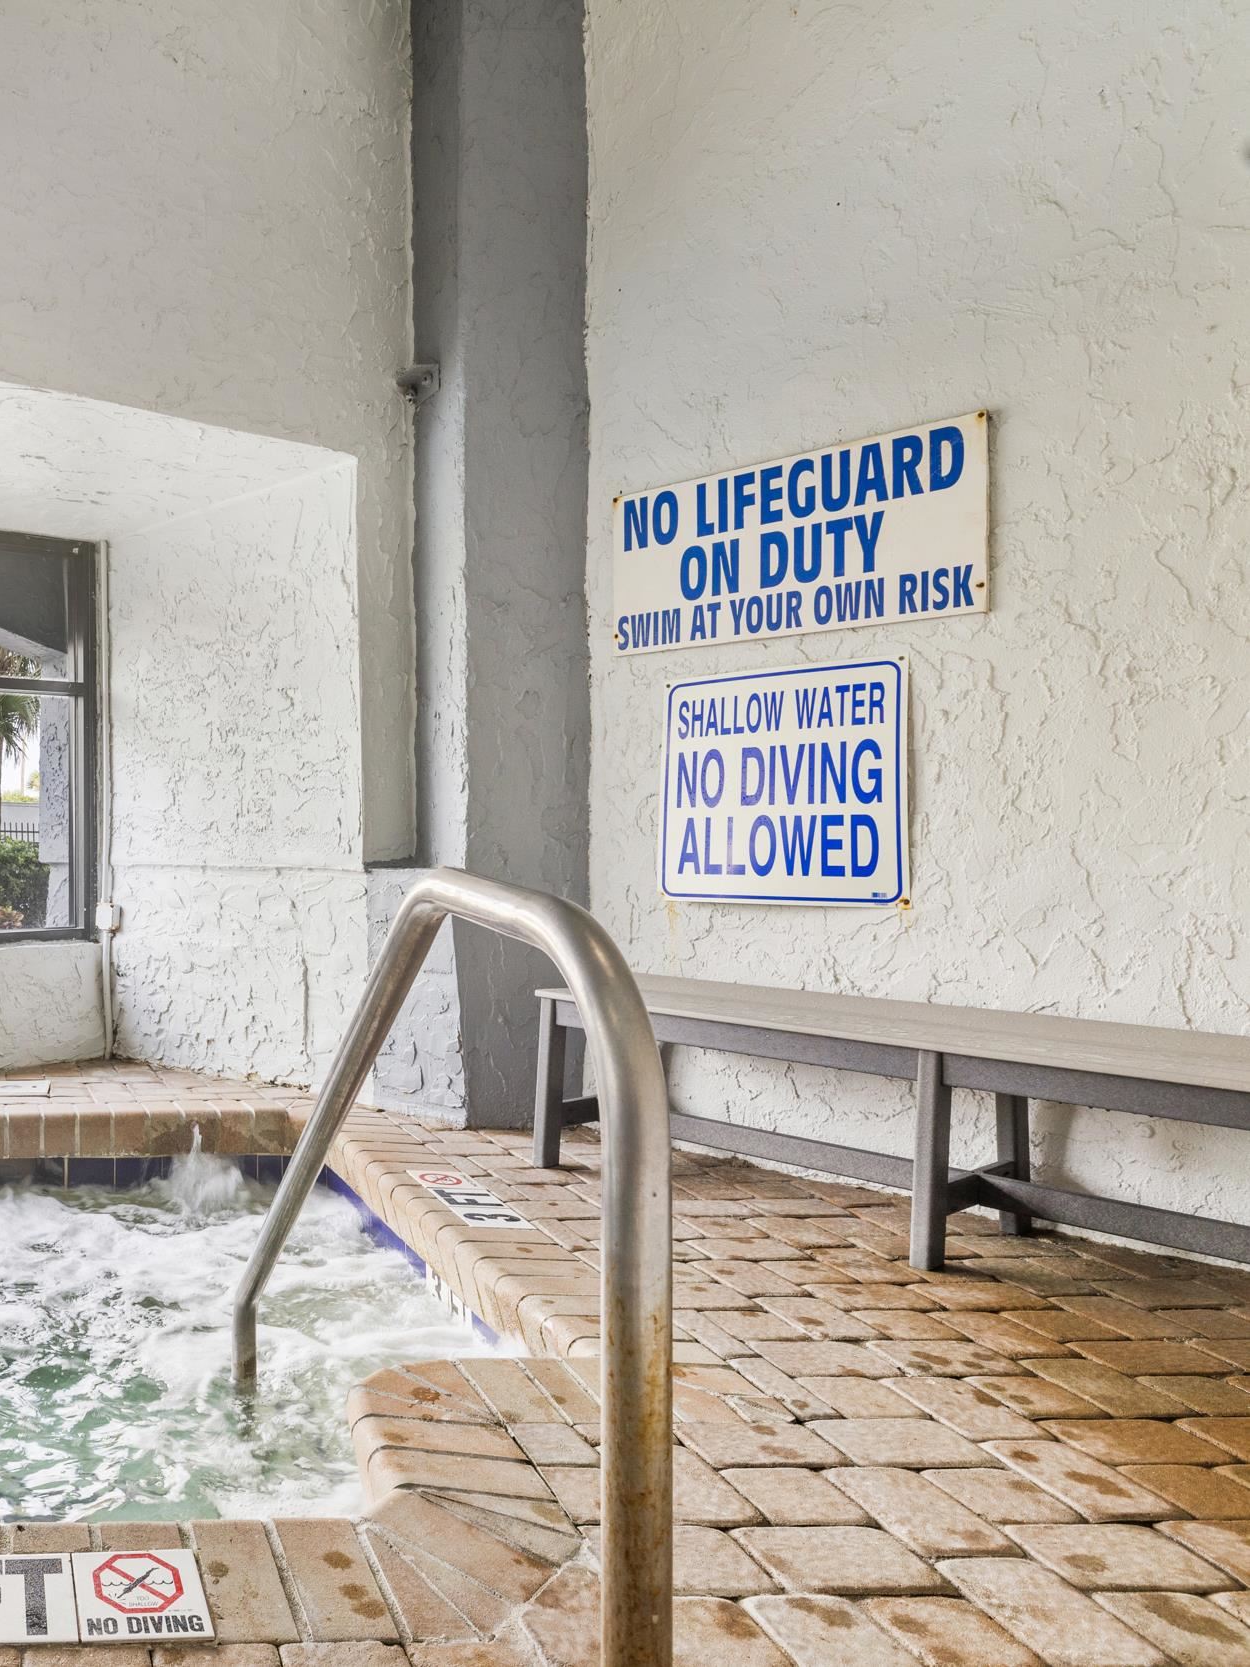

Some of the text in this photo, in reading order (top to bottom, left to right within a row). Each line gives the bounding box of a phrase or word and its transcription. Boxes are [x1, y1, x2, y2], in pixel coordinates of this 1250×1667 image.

[624, 425, 965, 552] NO LIFEGUARD
[680, 511, 885, 601] ON DUTY
[617, 564, 975, 650] SWIM AT YOUR OWN RISK
[678, 681, 885, 740] SHALLOW WATER
[676, 738, 883, 809] NO DIVING
[678, 814, 880, 878] ALLOWED
[434, 1189, 521, 1223] 3 FT
[86, 1615, 205, 1636] NO DIVING
